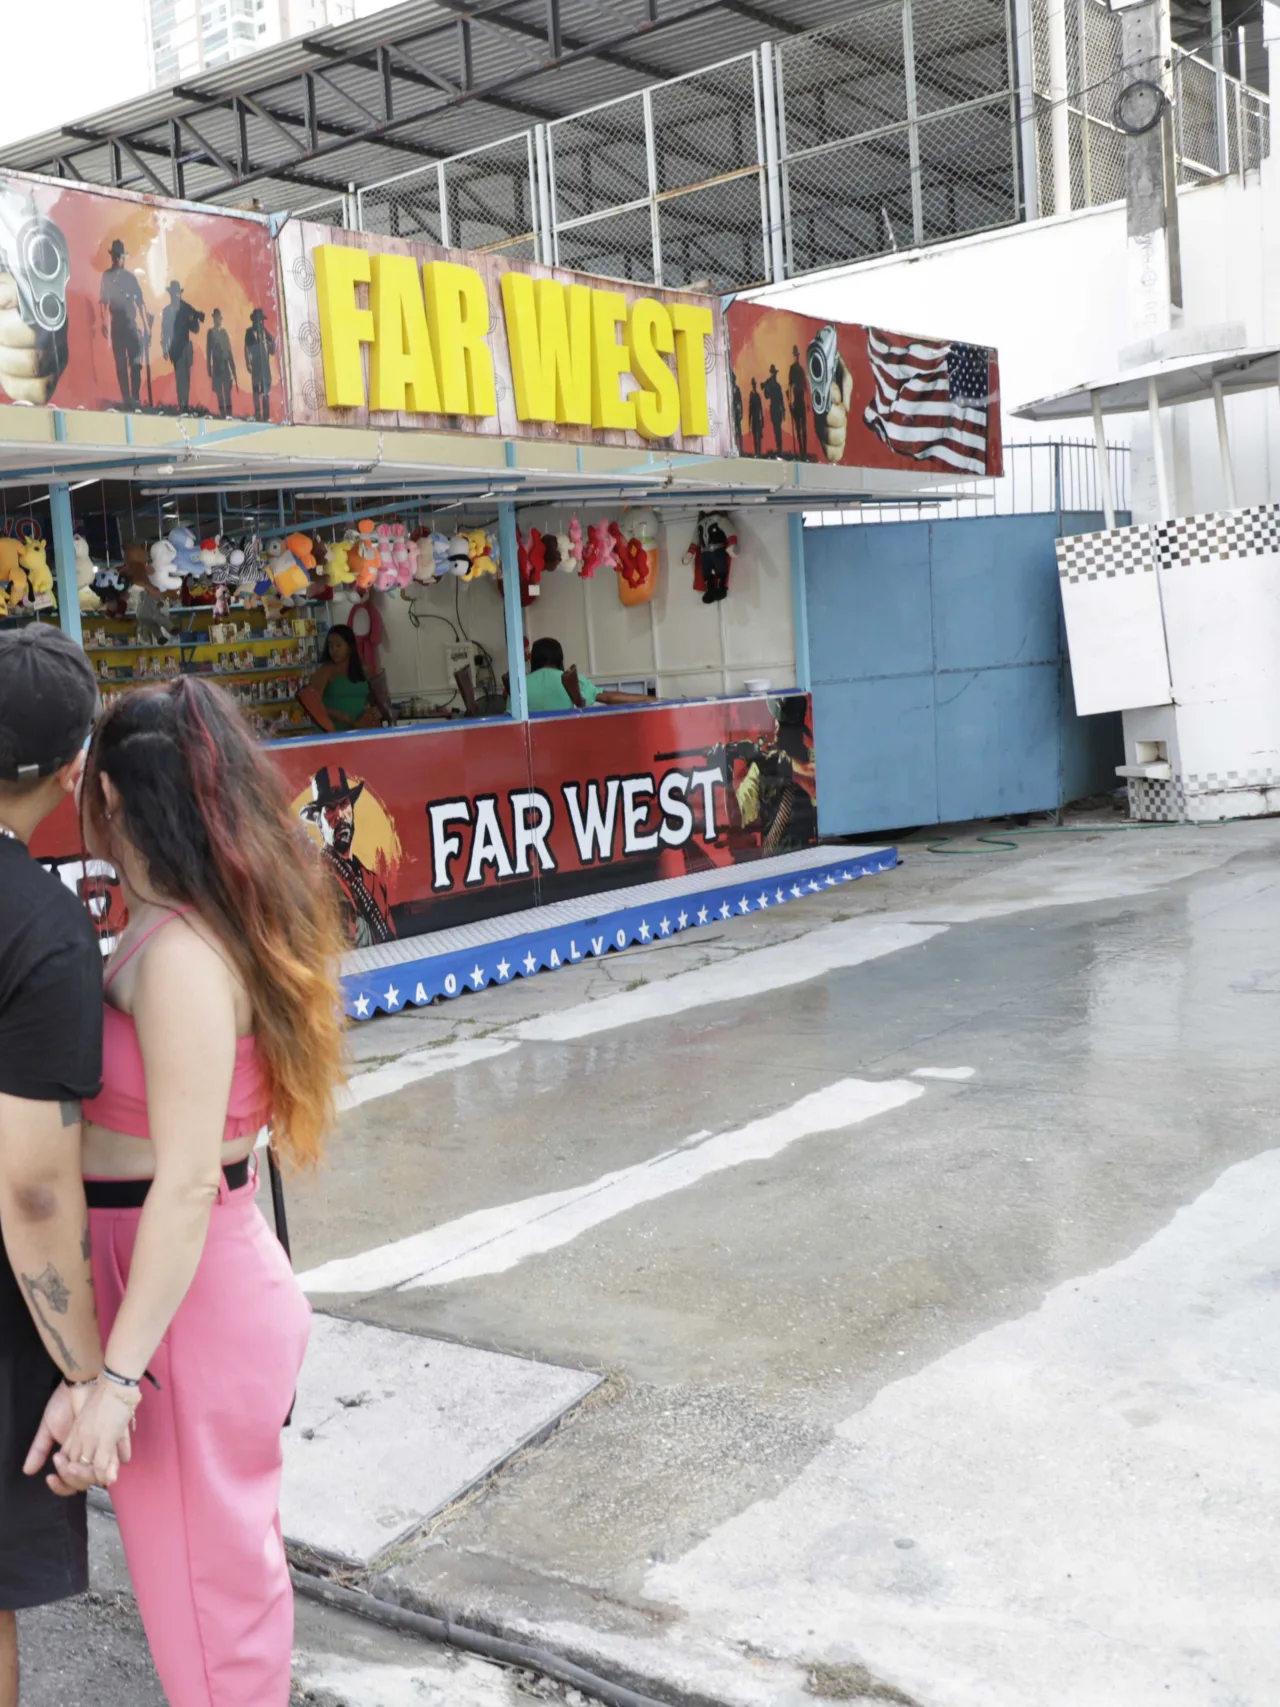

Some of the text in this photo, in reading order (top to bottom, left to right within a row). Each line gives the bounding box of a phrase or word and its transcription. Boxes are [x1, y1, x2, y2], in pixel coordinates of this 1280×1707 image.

[313, 244, 713, 440] FAR WEST
[430, 767, 724, 888] FAR WEST
